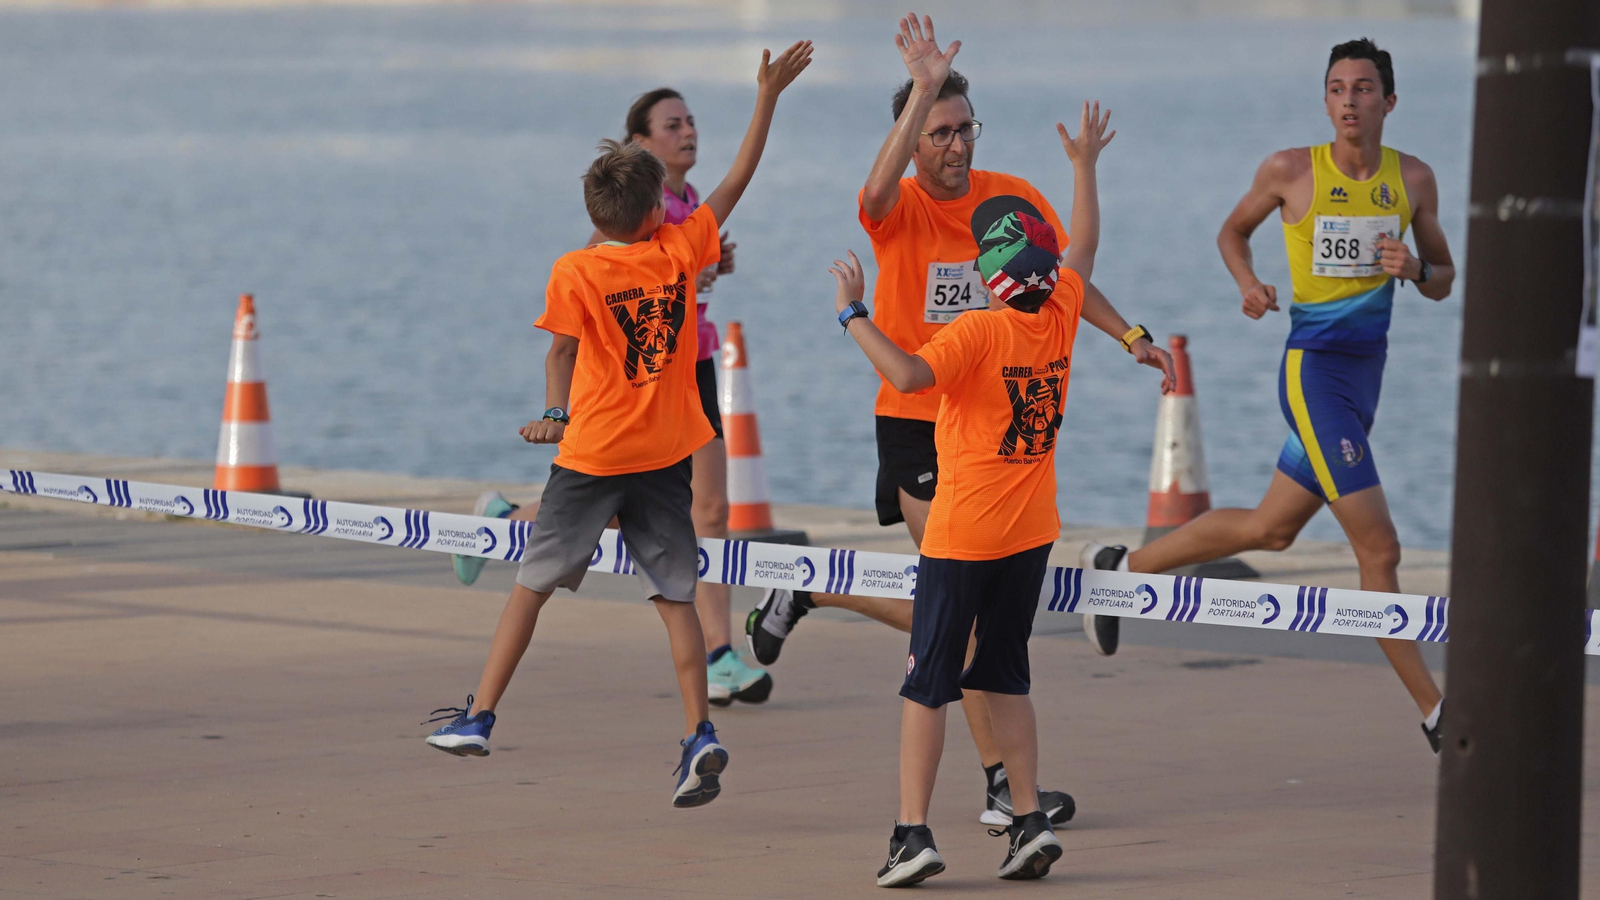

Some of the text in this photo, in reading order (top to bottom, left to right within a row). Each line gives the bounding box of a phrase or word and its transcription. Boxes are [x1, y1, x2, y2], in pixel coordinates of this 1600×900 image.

[1321, 238, 1360, 260] 368
[605, 286, 645, 306] CARRERA
[933, 282, 972, 306] 524
[236, 508, 274, 519] AUTORIDAD
[336, 518, 374, 529] AUTORIDAD
[333, 527, 373, 538] PORTUARIA
[438, 529, 477, 540] AUTORIDAD
[435, 538, 476, 549] PORTUARIA
[755, 560, 795, 571] AUTORIDAD
[754, 570, 795, 581] PORTUARIA
[862, 569, 904, 580] AUTORIDAD
[861, 579, 903, 590] PORTUARIA
[1090, 588, 1135, 599] AUTORIDAD
[1087, 597, 1134, 609] PORTUARIA
[1210, 597, 1257, 609] AUTORIDAD
[1207, 608, 1256, 619] PORTUARIA
[1335, 608, 1384, 620] AUTORIDAD
[1332, 618, 1382, 630] PORTUARIA
